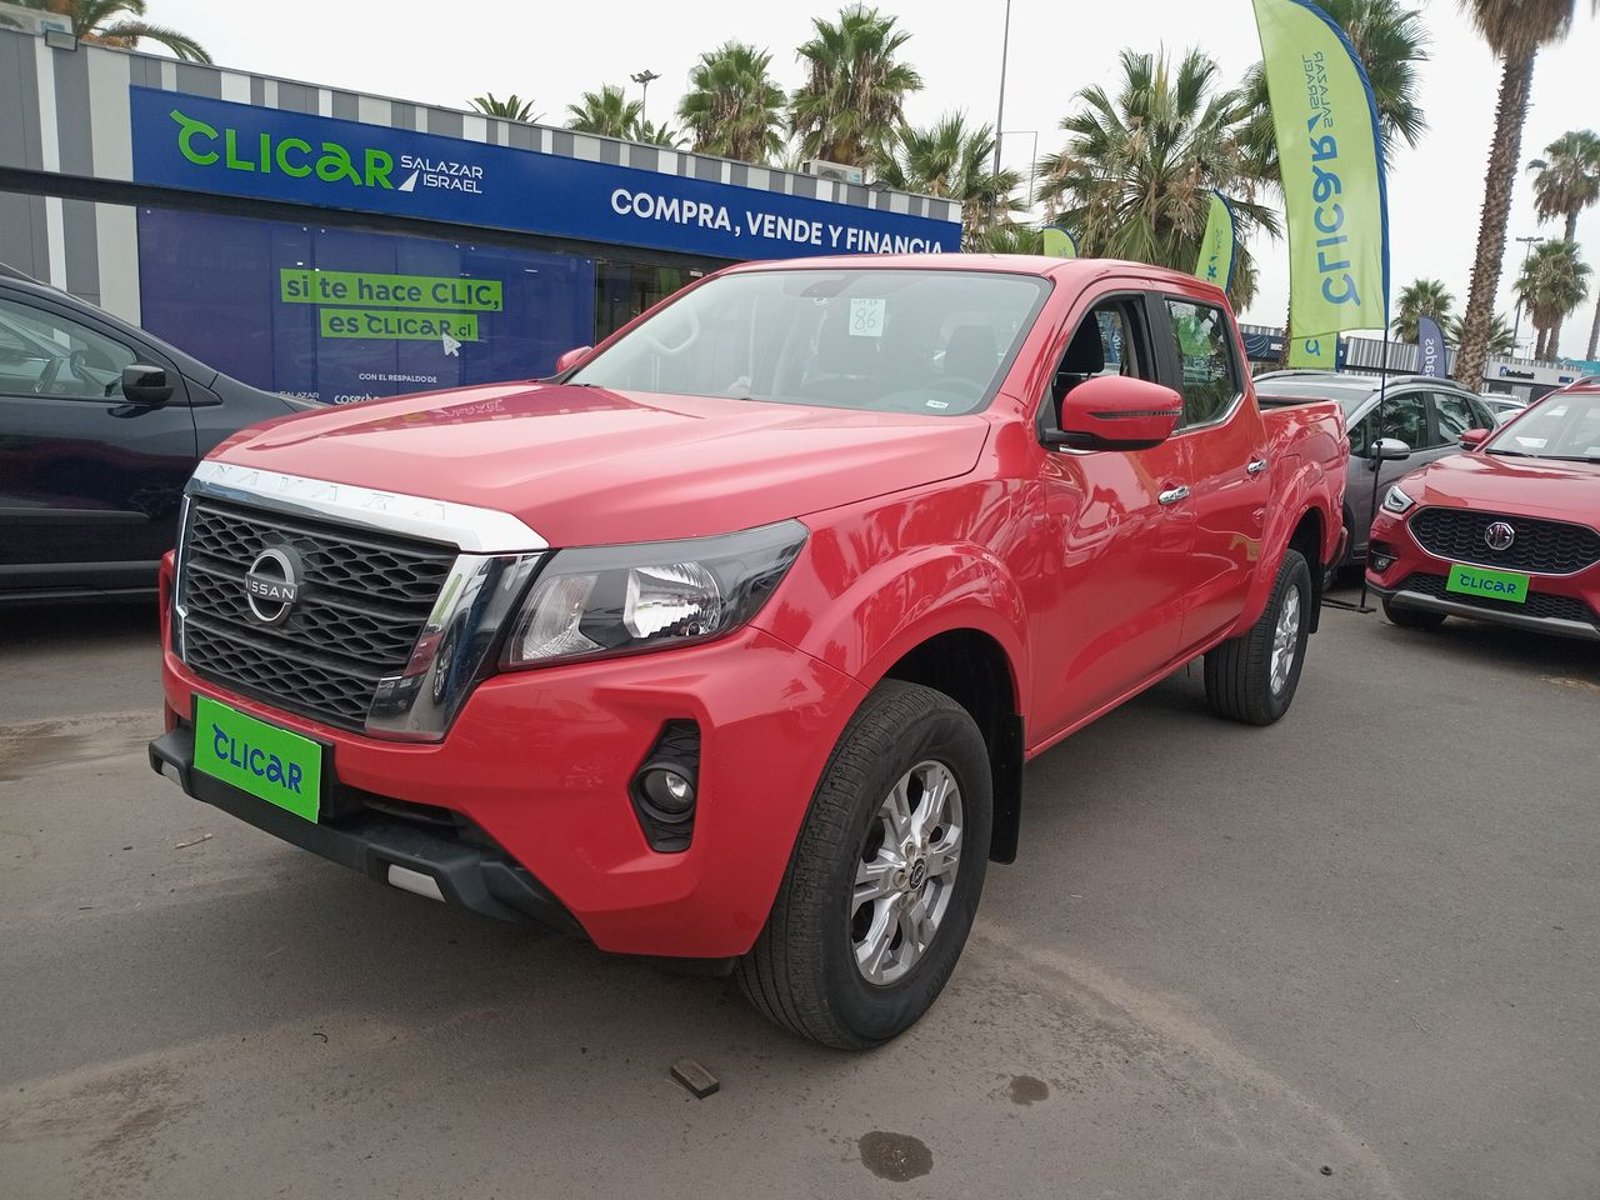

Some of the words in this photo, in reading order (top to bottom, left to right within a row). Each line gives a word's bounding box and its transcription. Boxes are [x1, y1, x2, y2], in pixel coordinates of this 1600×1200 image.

[400, 155, 483, 180] SALAZAR
[423, 173, 483, 194] ISRAEL
[611, 188, 741, 237] COMPRA,
[746, 211, 823, 246] VENDE
[828, 224, 844, 248] Y
[287, 275, 309, 297] si
[319, 277, 347, 299] te
[358, 278, 422, 301] hace
[431, 283, 500, 310] CLIC,
[329, 316, 359, 333] es
[854, 307, 878, 331] 86
[359, 373, 377, 381] CON
[388, 374, 427, 383] RESPALDO
